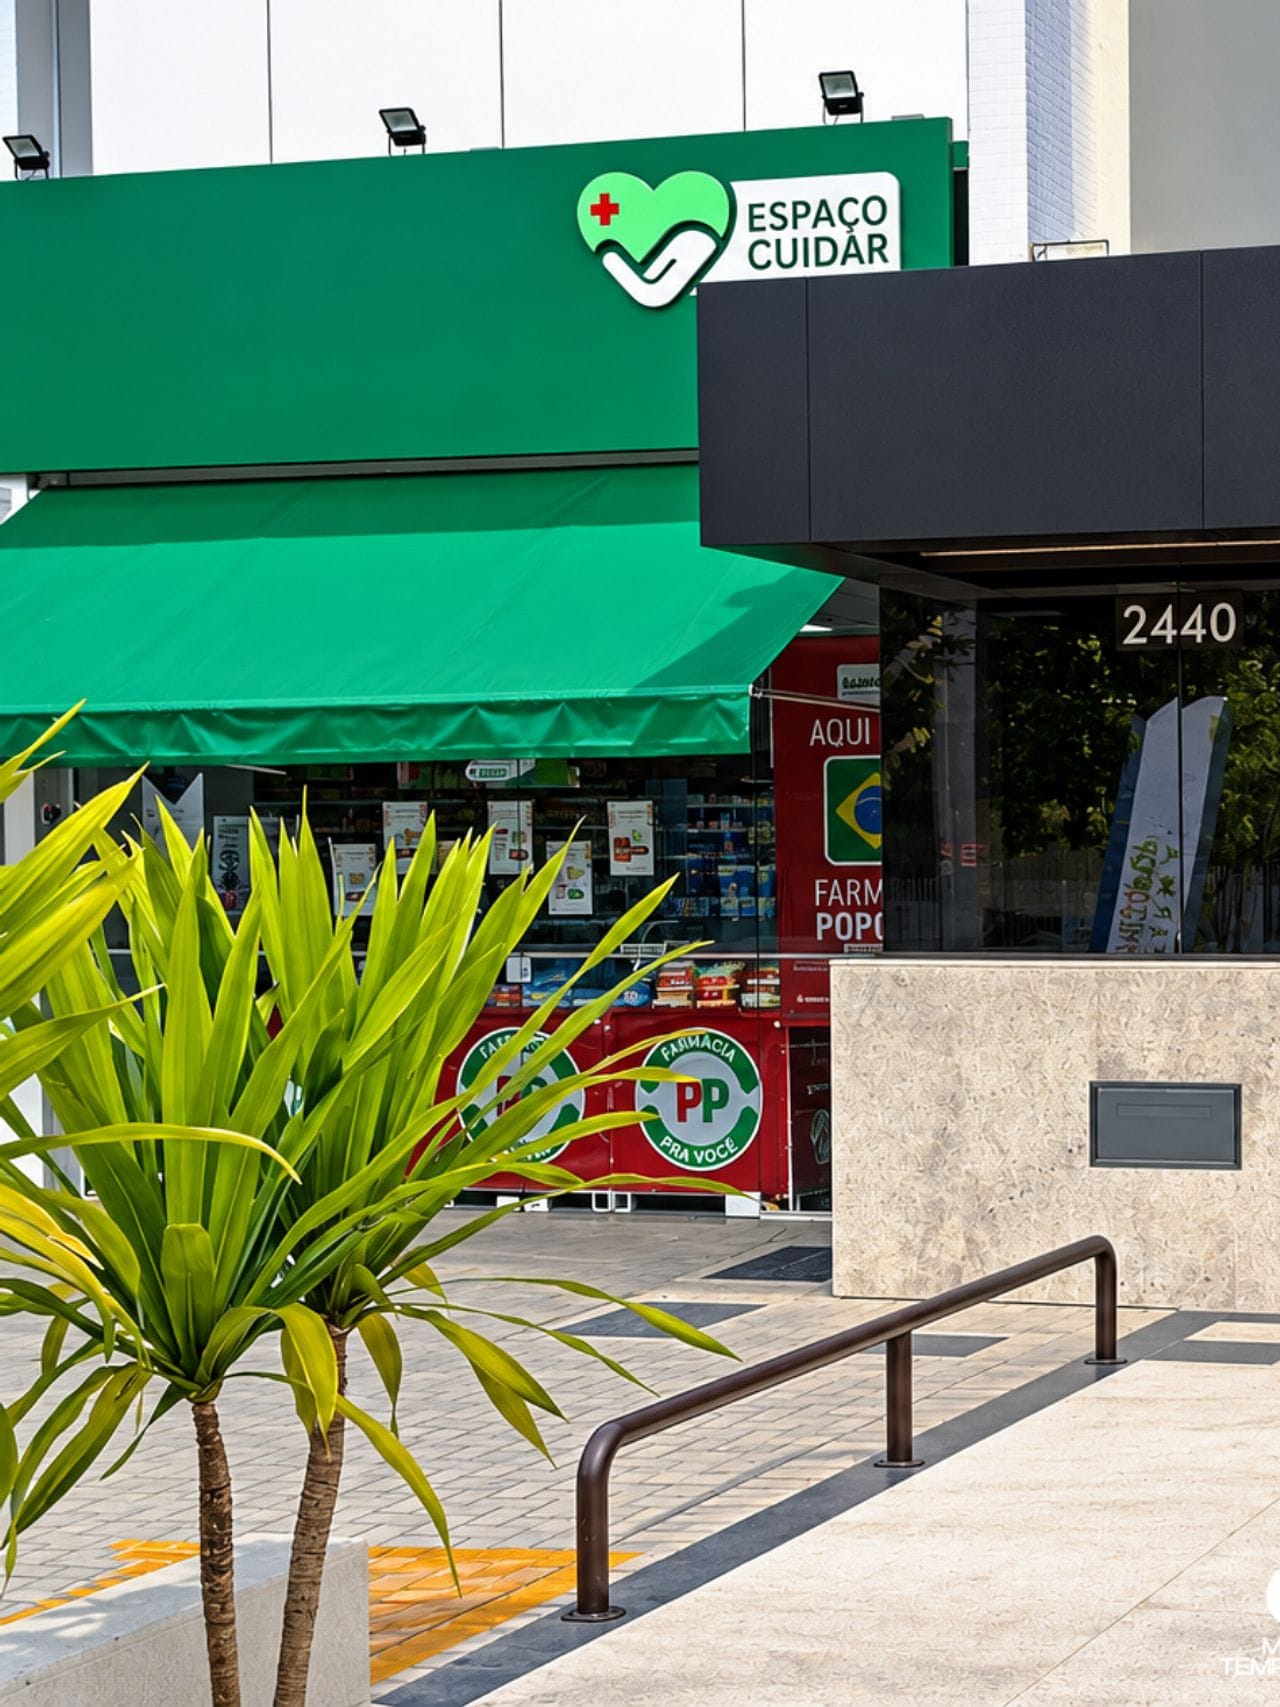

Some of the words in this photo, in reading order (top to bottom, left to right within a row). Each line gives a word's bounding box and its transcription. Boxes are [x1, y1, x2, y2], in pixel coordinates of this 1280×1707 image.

[748, 195, 888, 234] ESPAÇO
[748, 233, 889, 270] CUIDAR
[1122, 602, 1237, 645] 2440
[809, 717, 871, 747] AQUI
[676, 1078, 730, 1123] PP
[660, 1136, 690, 1162] PRA
